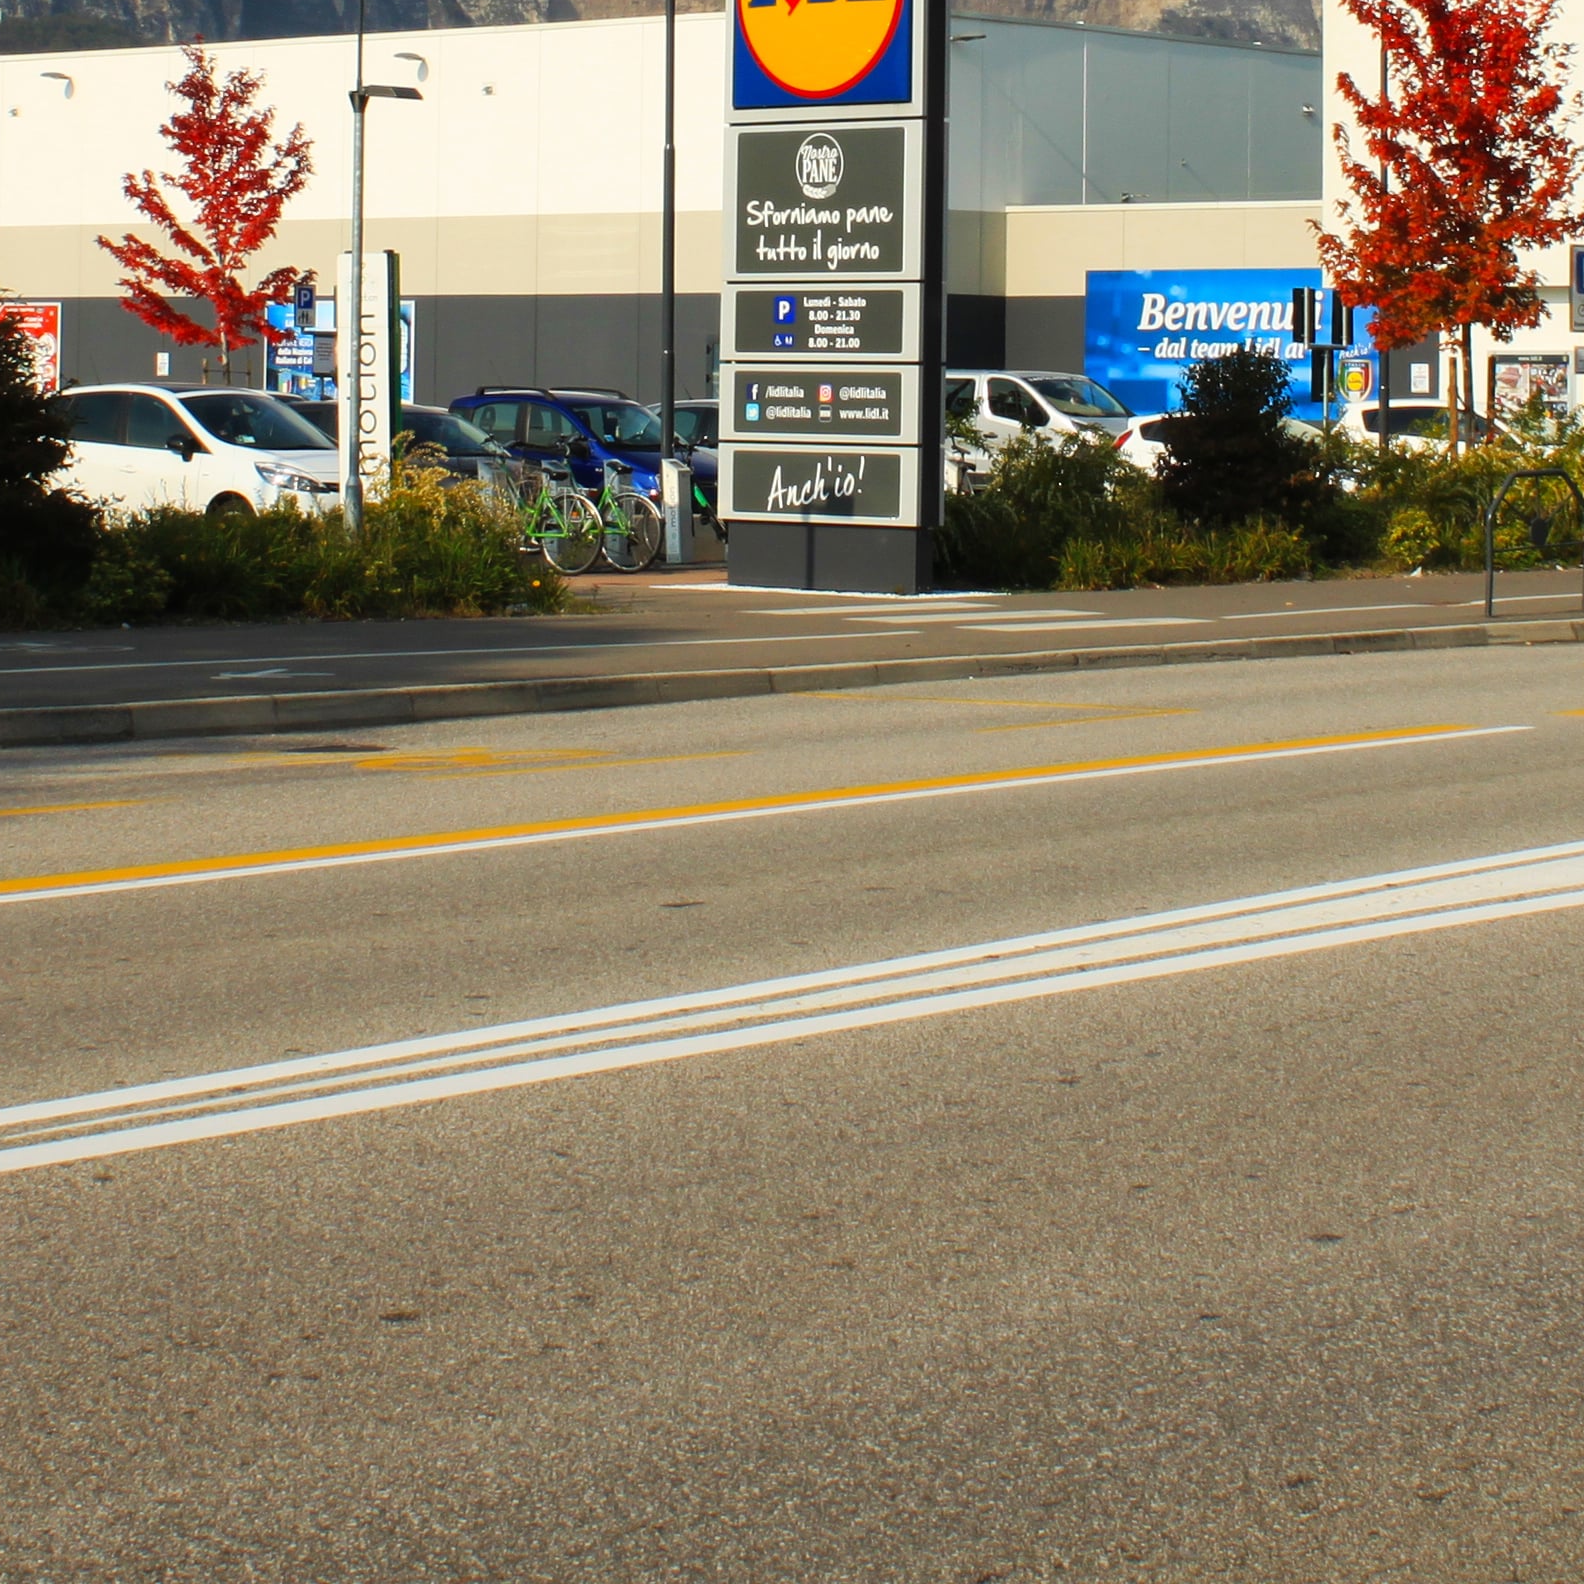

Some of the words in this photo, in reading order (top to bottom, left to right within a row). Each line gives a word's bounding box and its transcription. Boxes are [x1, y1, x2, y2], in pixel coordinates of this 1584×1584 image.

[800, 144, 839, 160] Nostro
[802, 158, 837, 183] PANE
[746, 200, 841, 228] Sforniamo
[846, 205, 893, 233] pane
[756, 234, 807, 261] tutto
[812, 229, 822, 260] il
[827, 238, 880, 270] giorno
[300, 290, 311, 306] P
[838, 296, 867, 307] Sabato
[778, 300, 790, 320] P
[809, 310, 829, 321] 8.00
[835, 310, 861, 321] 21.30
[1137, 290, 1325, 331] Benvenui
[814, 324, 854, 335] Domenica
[808, 338, 828, 348] 8.00
[835, 338, 860, 348] 21.00
[1154, 337, 1187, 359] dal
[1190, 338, 1238, 359] team
[765, 385, 805, 399] /lidlitalia
[839, 386, 886, 400] @lidlitalia
[766, 405, 812, 420] @lidlitalia
[839, 407, 889, 420] www.lidl.it
[767, 455, 866, 512] Anch'io!
